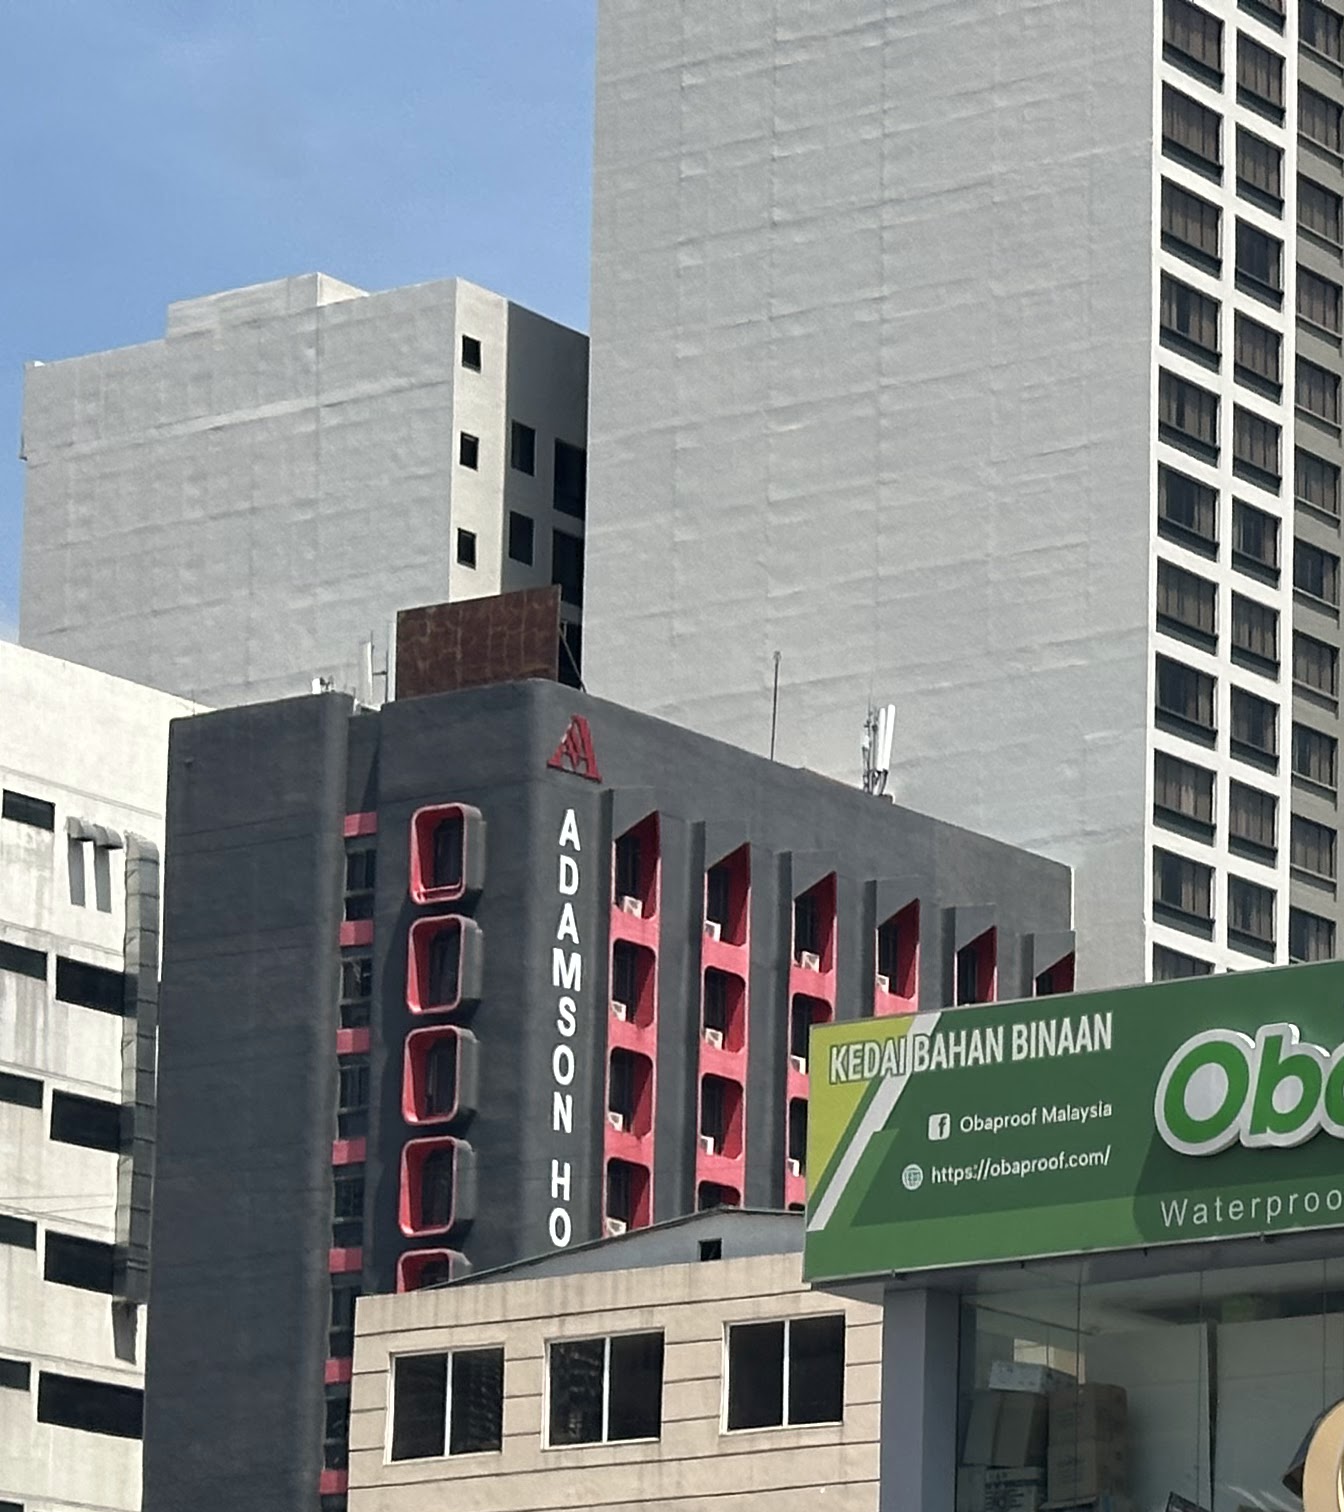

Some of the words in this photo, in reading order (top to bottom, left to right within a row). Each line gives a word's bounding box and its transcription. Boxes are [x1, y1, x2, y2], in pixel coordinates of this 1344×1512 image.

[552, 808, 582, 1133] ADAMSON
[829, 1036, 906, 1084] KEDAI
[913, 1026, 1004, 1073] BAHAN
[1011, 1012, 1113, 1061] BINAAN
[960, 1108, 1036, 1133] Obaproof
[1042, 1101, 1112, 1125] Malaysia
[931, 1145, 1111, 1185] https://obaproof.com/
